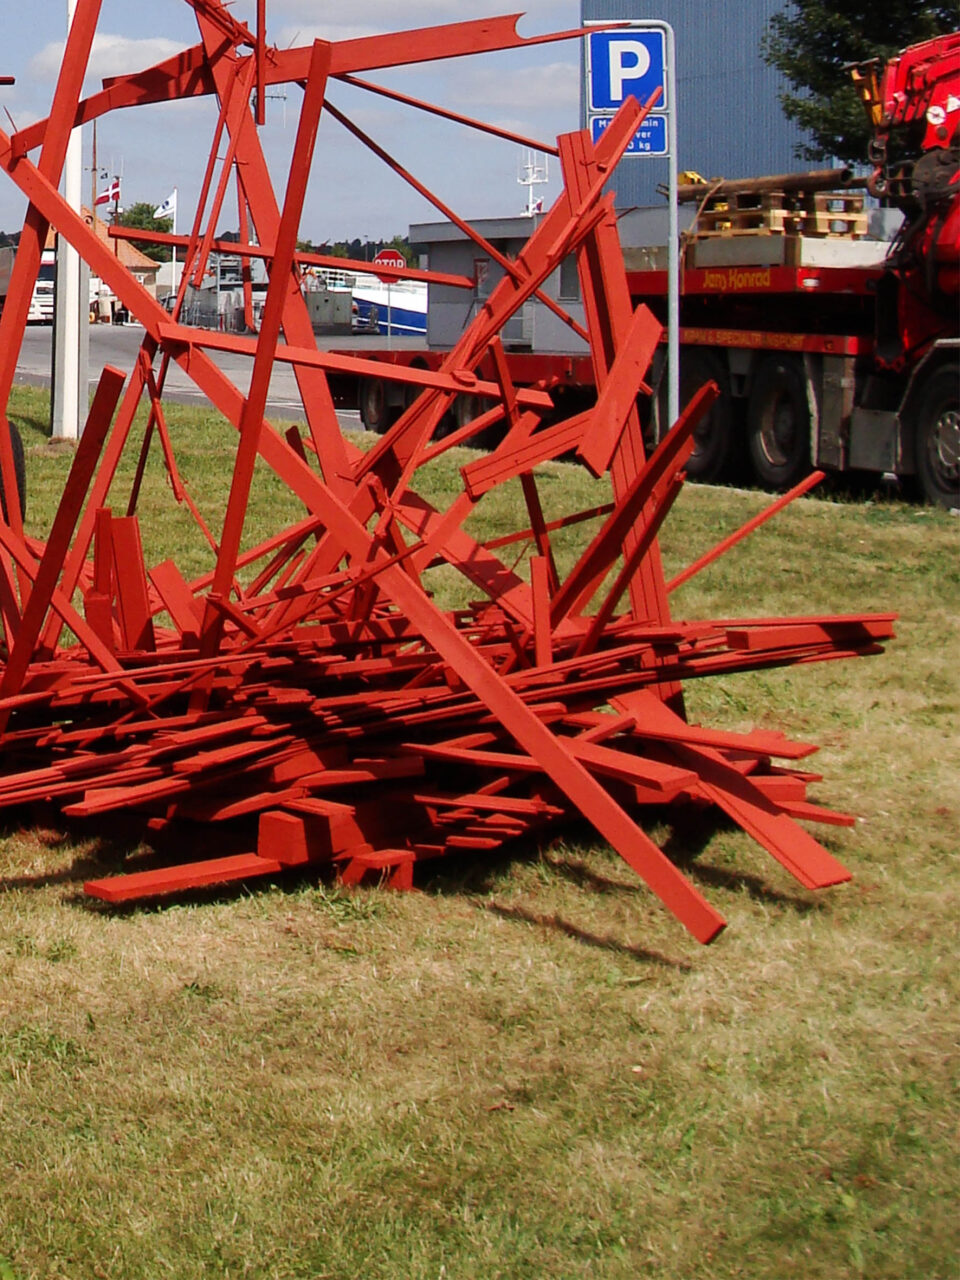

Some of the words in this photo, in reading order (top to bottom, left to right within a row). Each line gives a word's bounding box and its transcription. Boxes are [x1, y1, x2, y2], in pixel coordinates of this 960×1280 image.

[608, 40, 650, 101] P
[639, 141, 651, 151] kg
[728, 268, 771, 291] Konrad
[715, 330, 805, 349] SPECIALTRNSPORT
